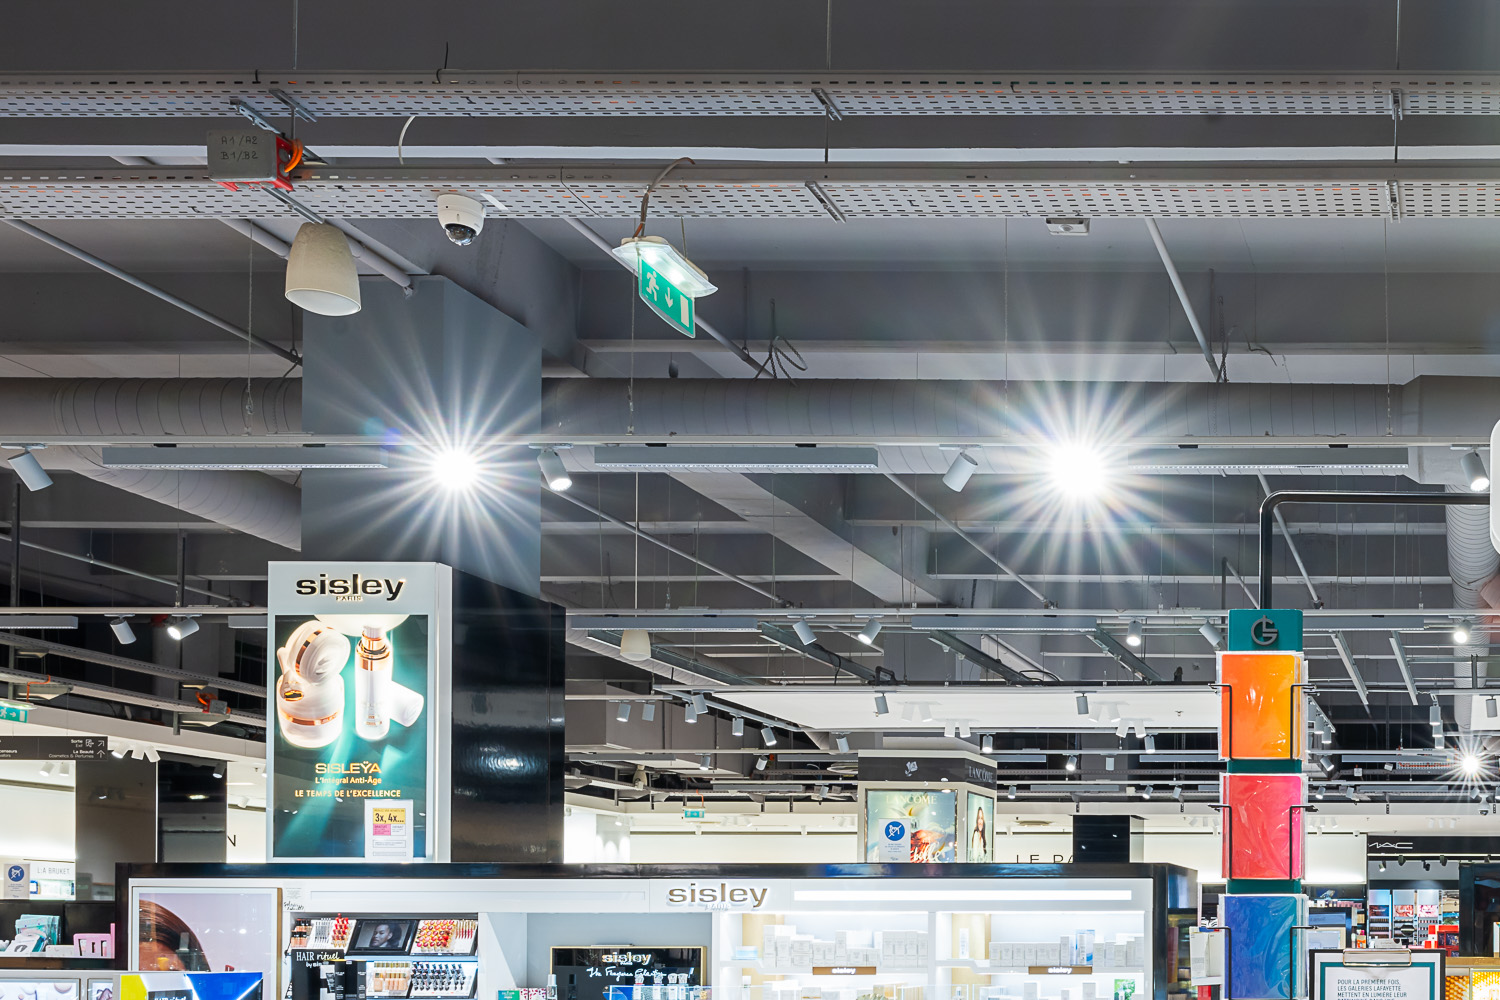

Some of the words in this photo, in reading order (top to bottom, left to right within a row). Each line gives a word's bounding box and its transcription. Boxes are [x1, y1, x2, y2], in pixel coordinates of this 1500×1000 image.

[295, 573, 406, 601] sisley
[350, 775, 382, 786] Anti-Âge
[294, 789, 304, 797] LE
[306, 789, 332, 797] TEMPS
[334, 789, 344, 797] DE
[346, 789, 401, 797] L'EXCELLENCE
[668, 883, 768, 908] sisley
[296, 951, 314, 961] HAIR
[316, 951, 340, 961] rituel
